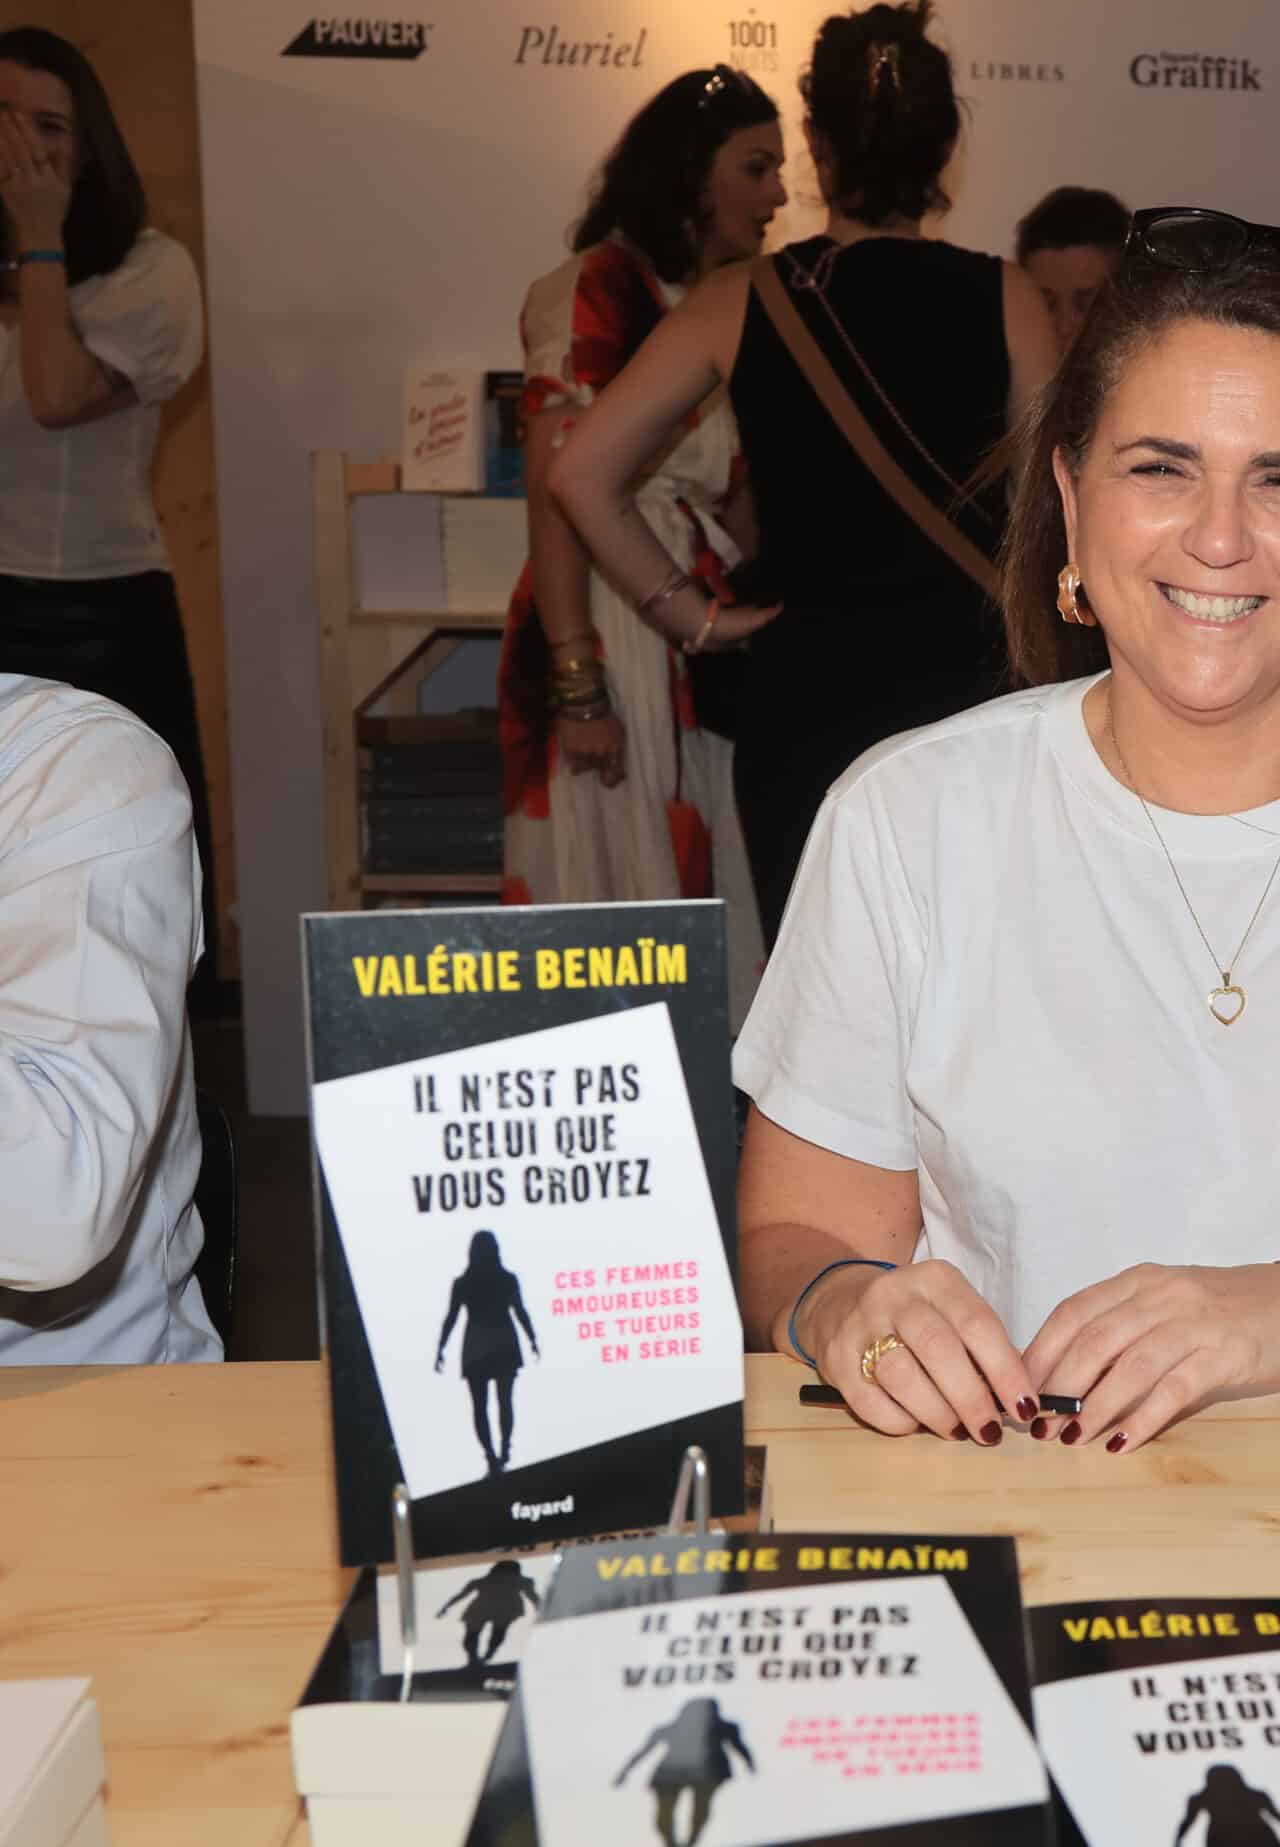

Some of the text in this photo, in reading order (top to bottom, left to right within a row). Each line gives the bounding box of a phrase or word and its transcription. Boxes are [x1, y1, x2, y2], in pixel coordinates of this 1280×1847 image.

[513, 24, 648, 68] Pluriel
[728, 20, 777, 49] 1001
[970, 62, 1065, 82] LIBRES
[1128, 53, 1262, 92] Graffik
[352, 937, 688, 997] VALÉRIE BENAÏM
[413, 1063, 640, 1113] IL N'EST PAS
[443, 1113, 615, 1162] CELUI QUE
[412, 1156, 651, 1214] VOUS CROYEZ
[554, 1260, 699, 1291] CES FEMMES
[551, 1285, 700, 1316] AMOUREUSES
[577, 1311, 701, 1341] DE TUEURS
[600, 1343, 631, 1365] EN
[510, 1495, 574, 1522] fayard
[598, 1544, 970, 1580] VALÉRIE BENAÏM
[1063, 1611, 1238, 1641] VALÉRIE
[1131, 1677, 1157, 1698] IL
[1167, 1699, 1275, 1723] CELUI
[1135, 1727, 1244, 1755] VOUS
